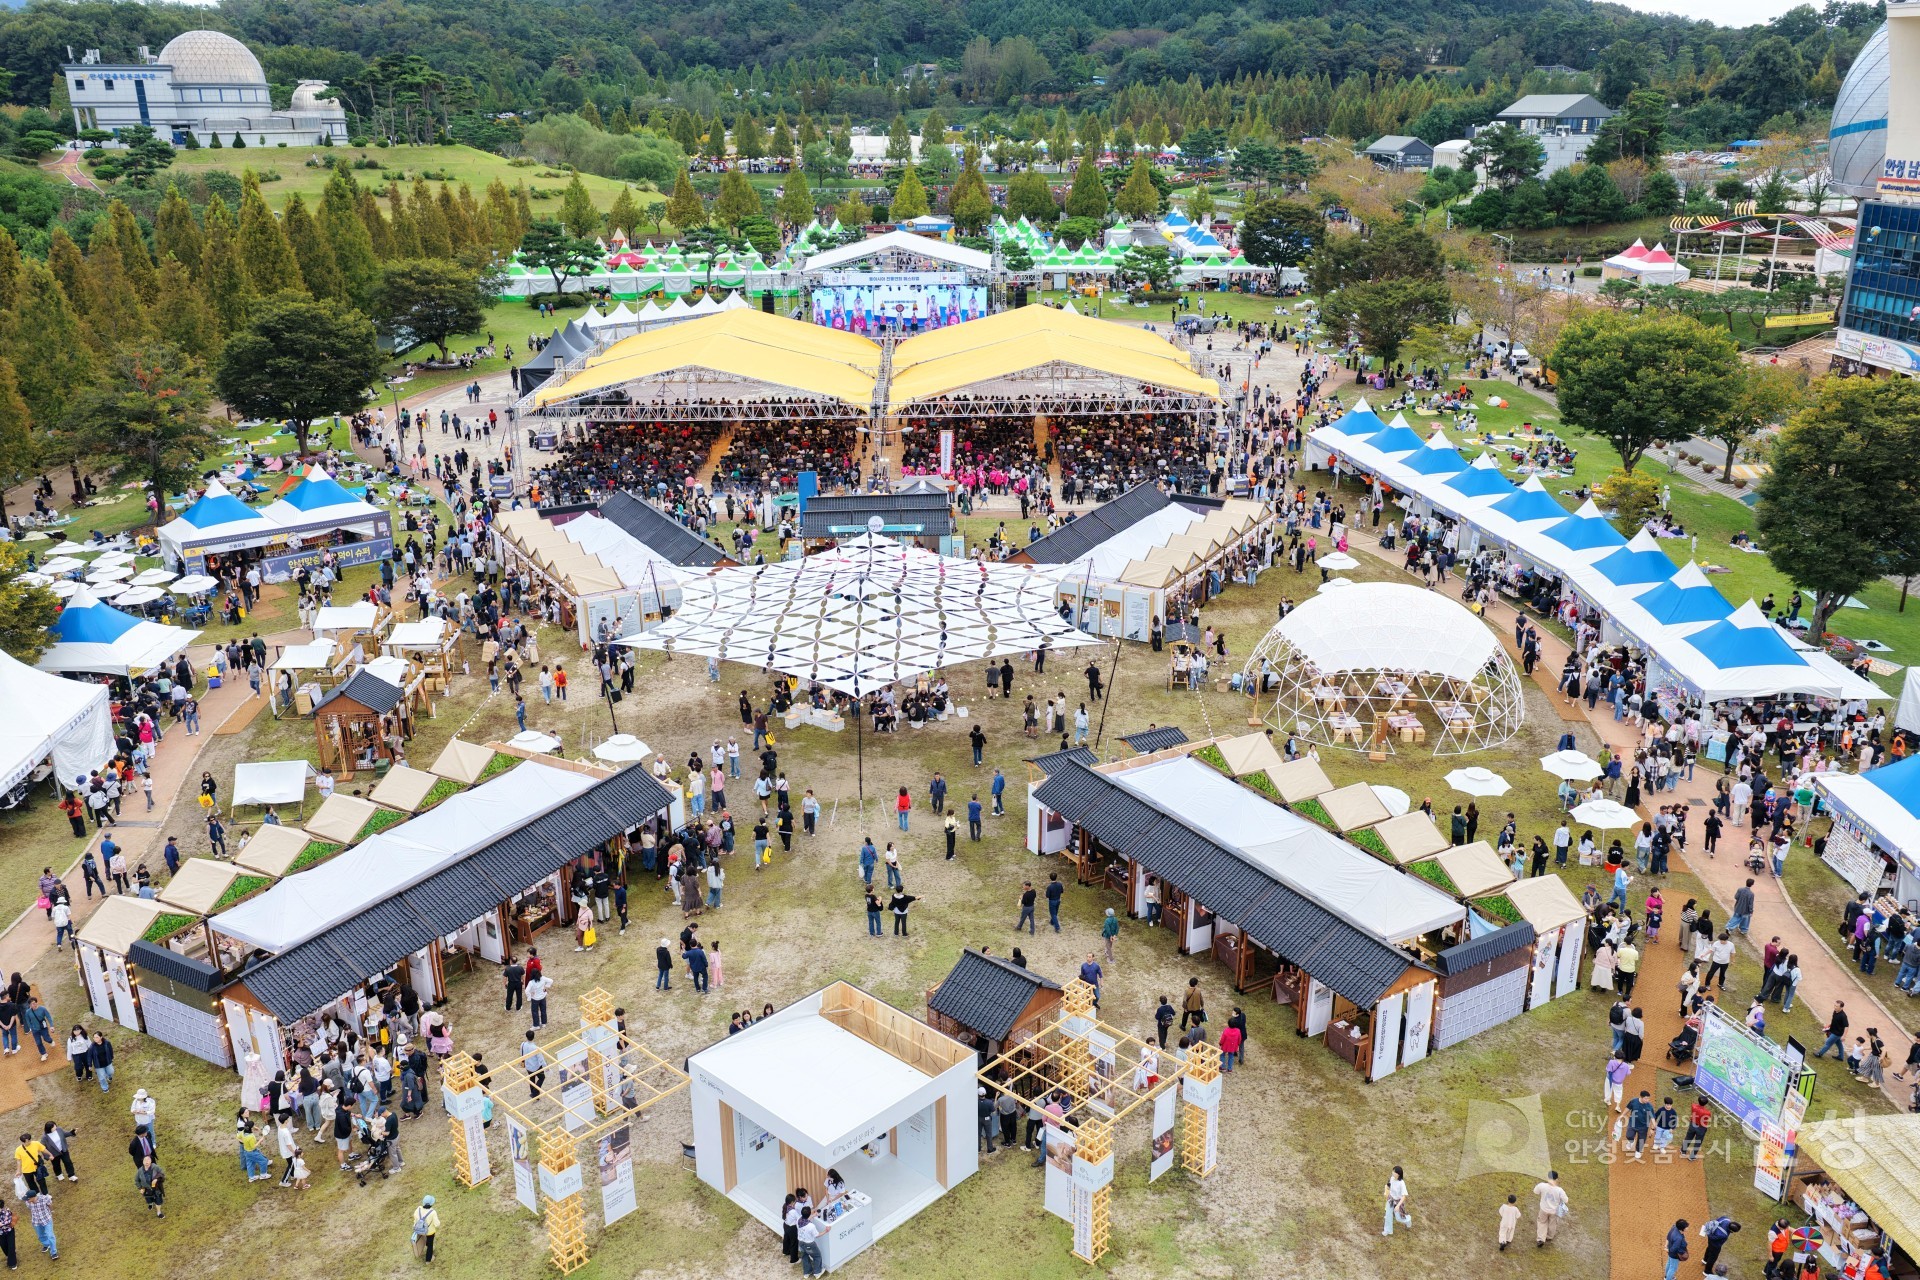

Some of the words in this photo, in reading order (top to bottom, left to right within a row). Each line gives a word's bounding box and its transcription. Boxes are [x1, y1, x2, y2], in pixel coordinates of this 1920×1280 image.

[1884, 158, 1907, 179] 안성
[1908, 160, 1920, 179] 남
[355, 546, 371, 558] 슈퍼
[1709, 1019, 1722, 1030] MAP
[845, 1126, 876, 1149] 안성문화장
